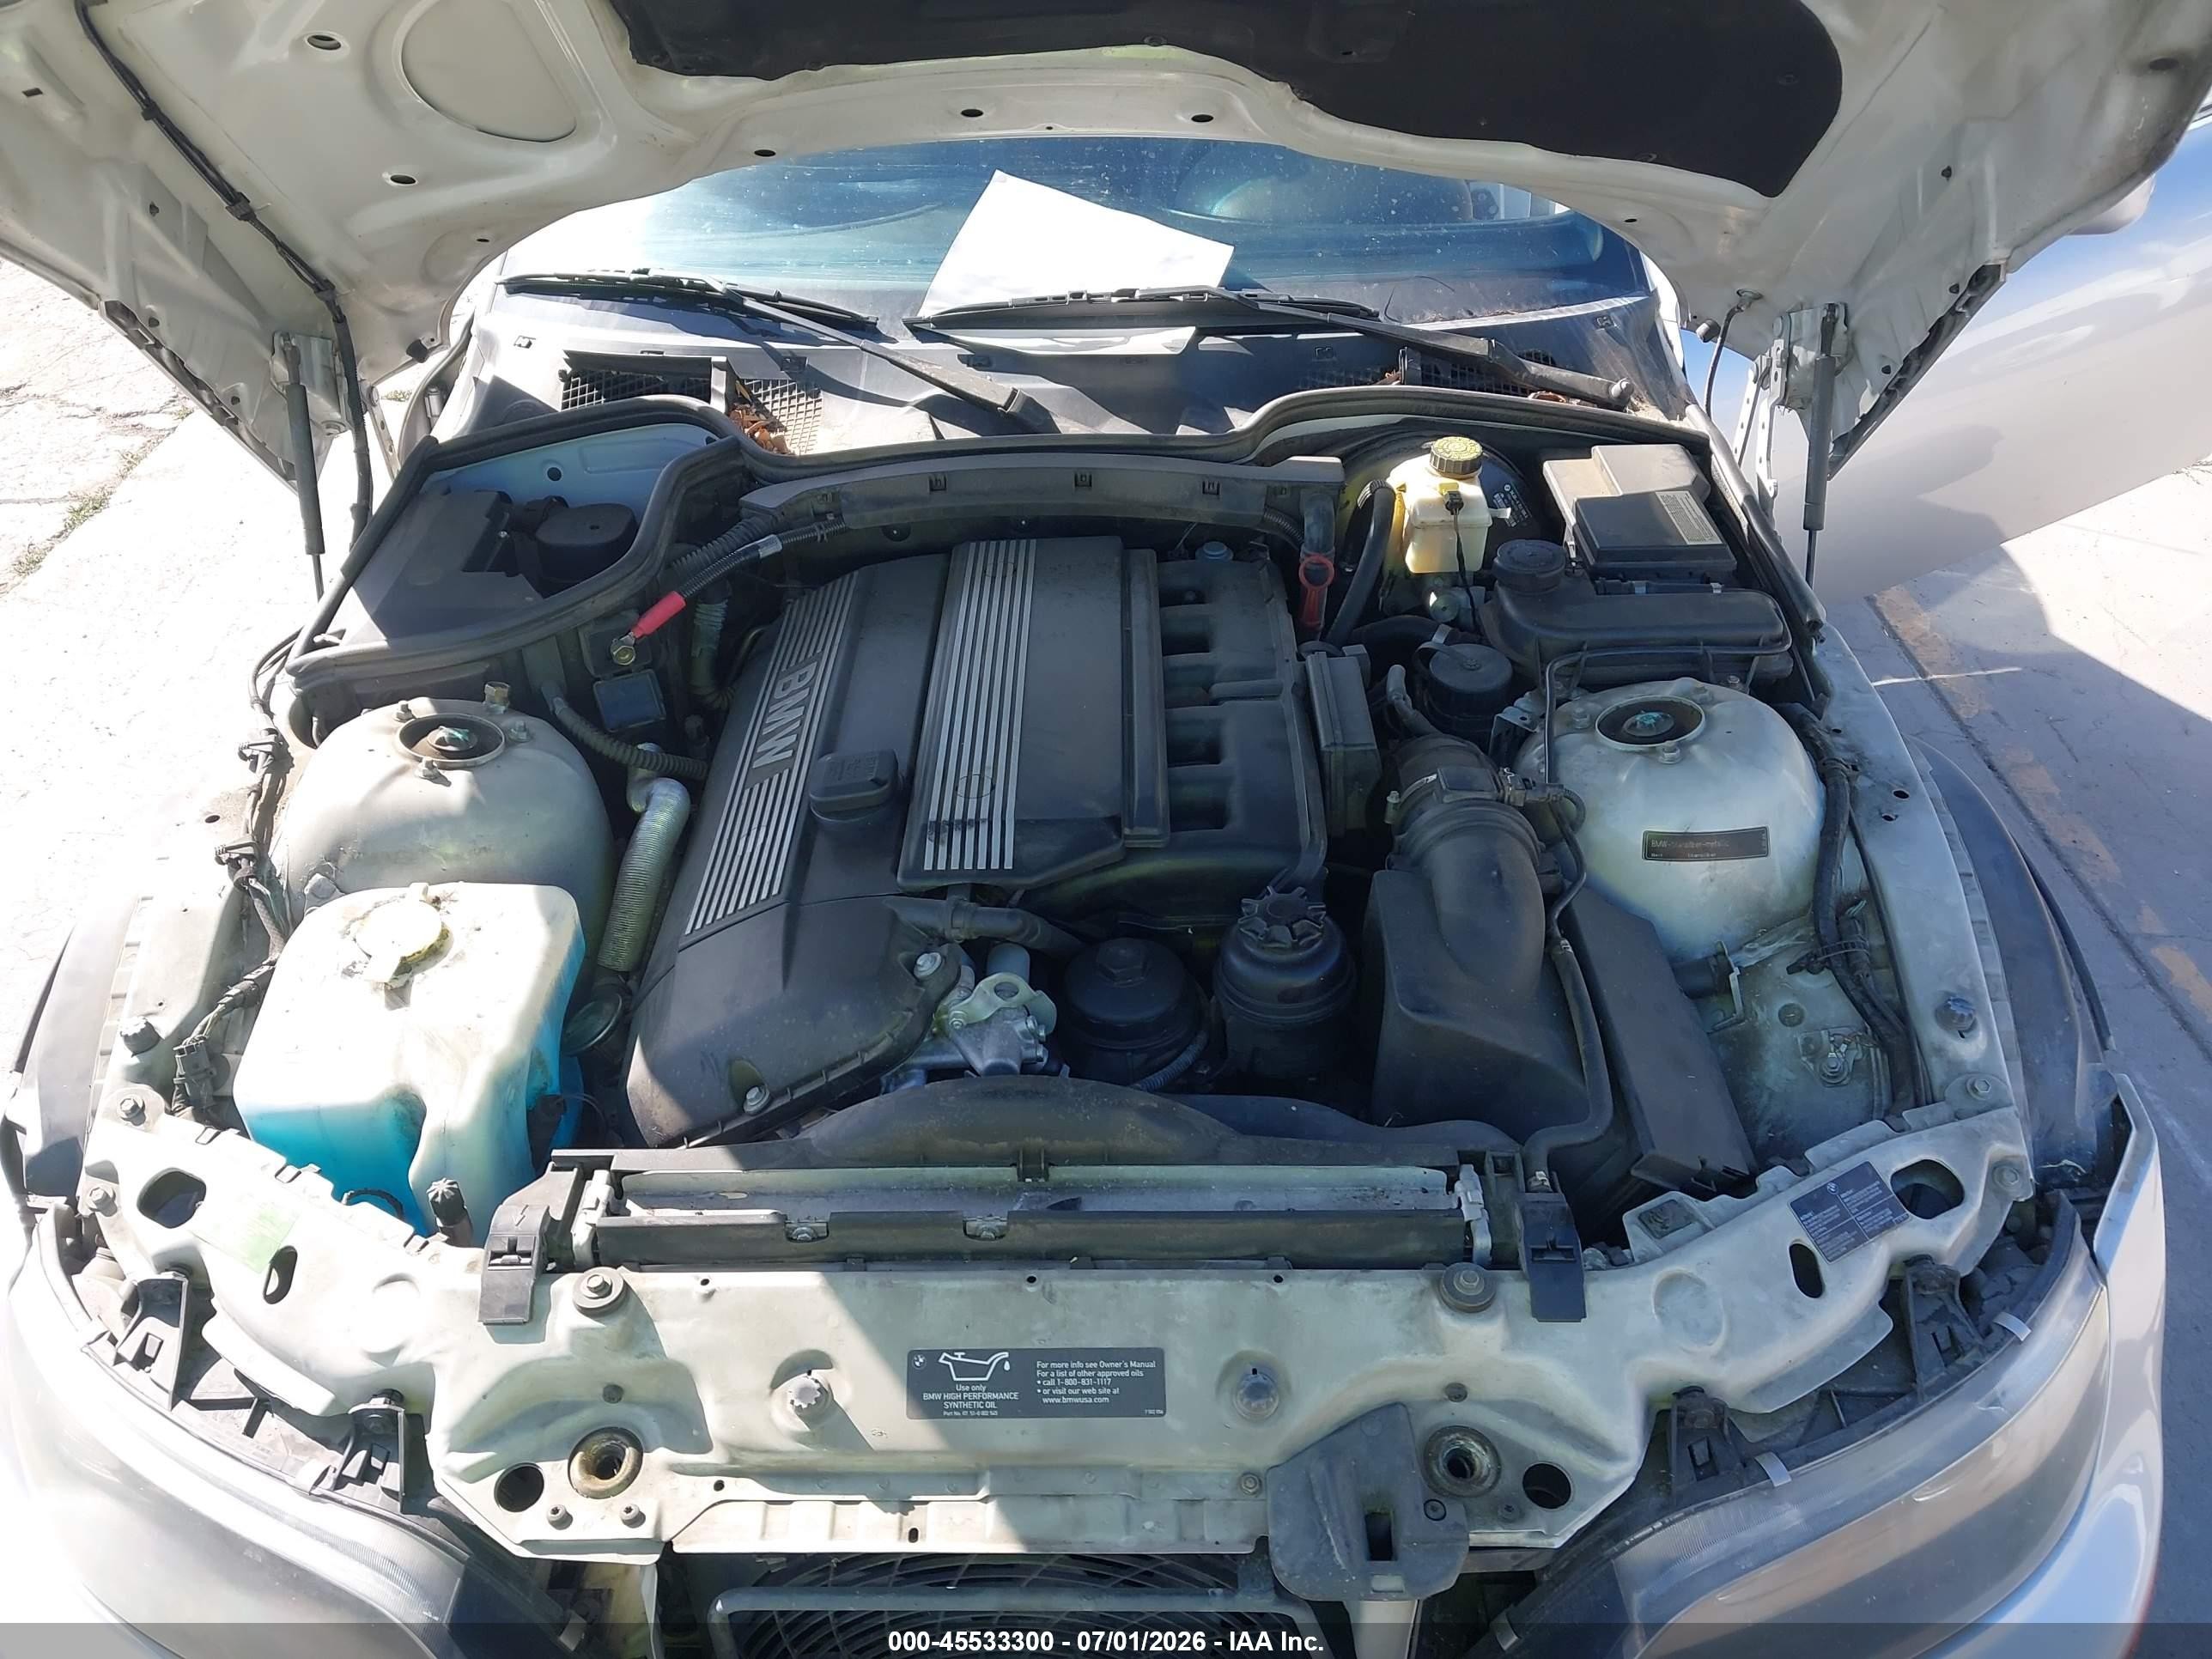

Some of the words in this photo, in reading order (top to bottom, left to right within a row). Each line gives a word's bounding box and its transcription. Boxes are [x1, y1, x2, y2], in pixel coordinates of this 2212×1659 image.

[752, 662, 817, 769] BMW
[1097, 1370, 1129, 1378] approved
[963, 1392, 1019, 1401] PERFORMANCE
